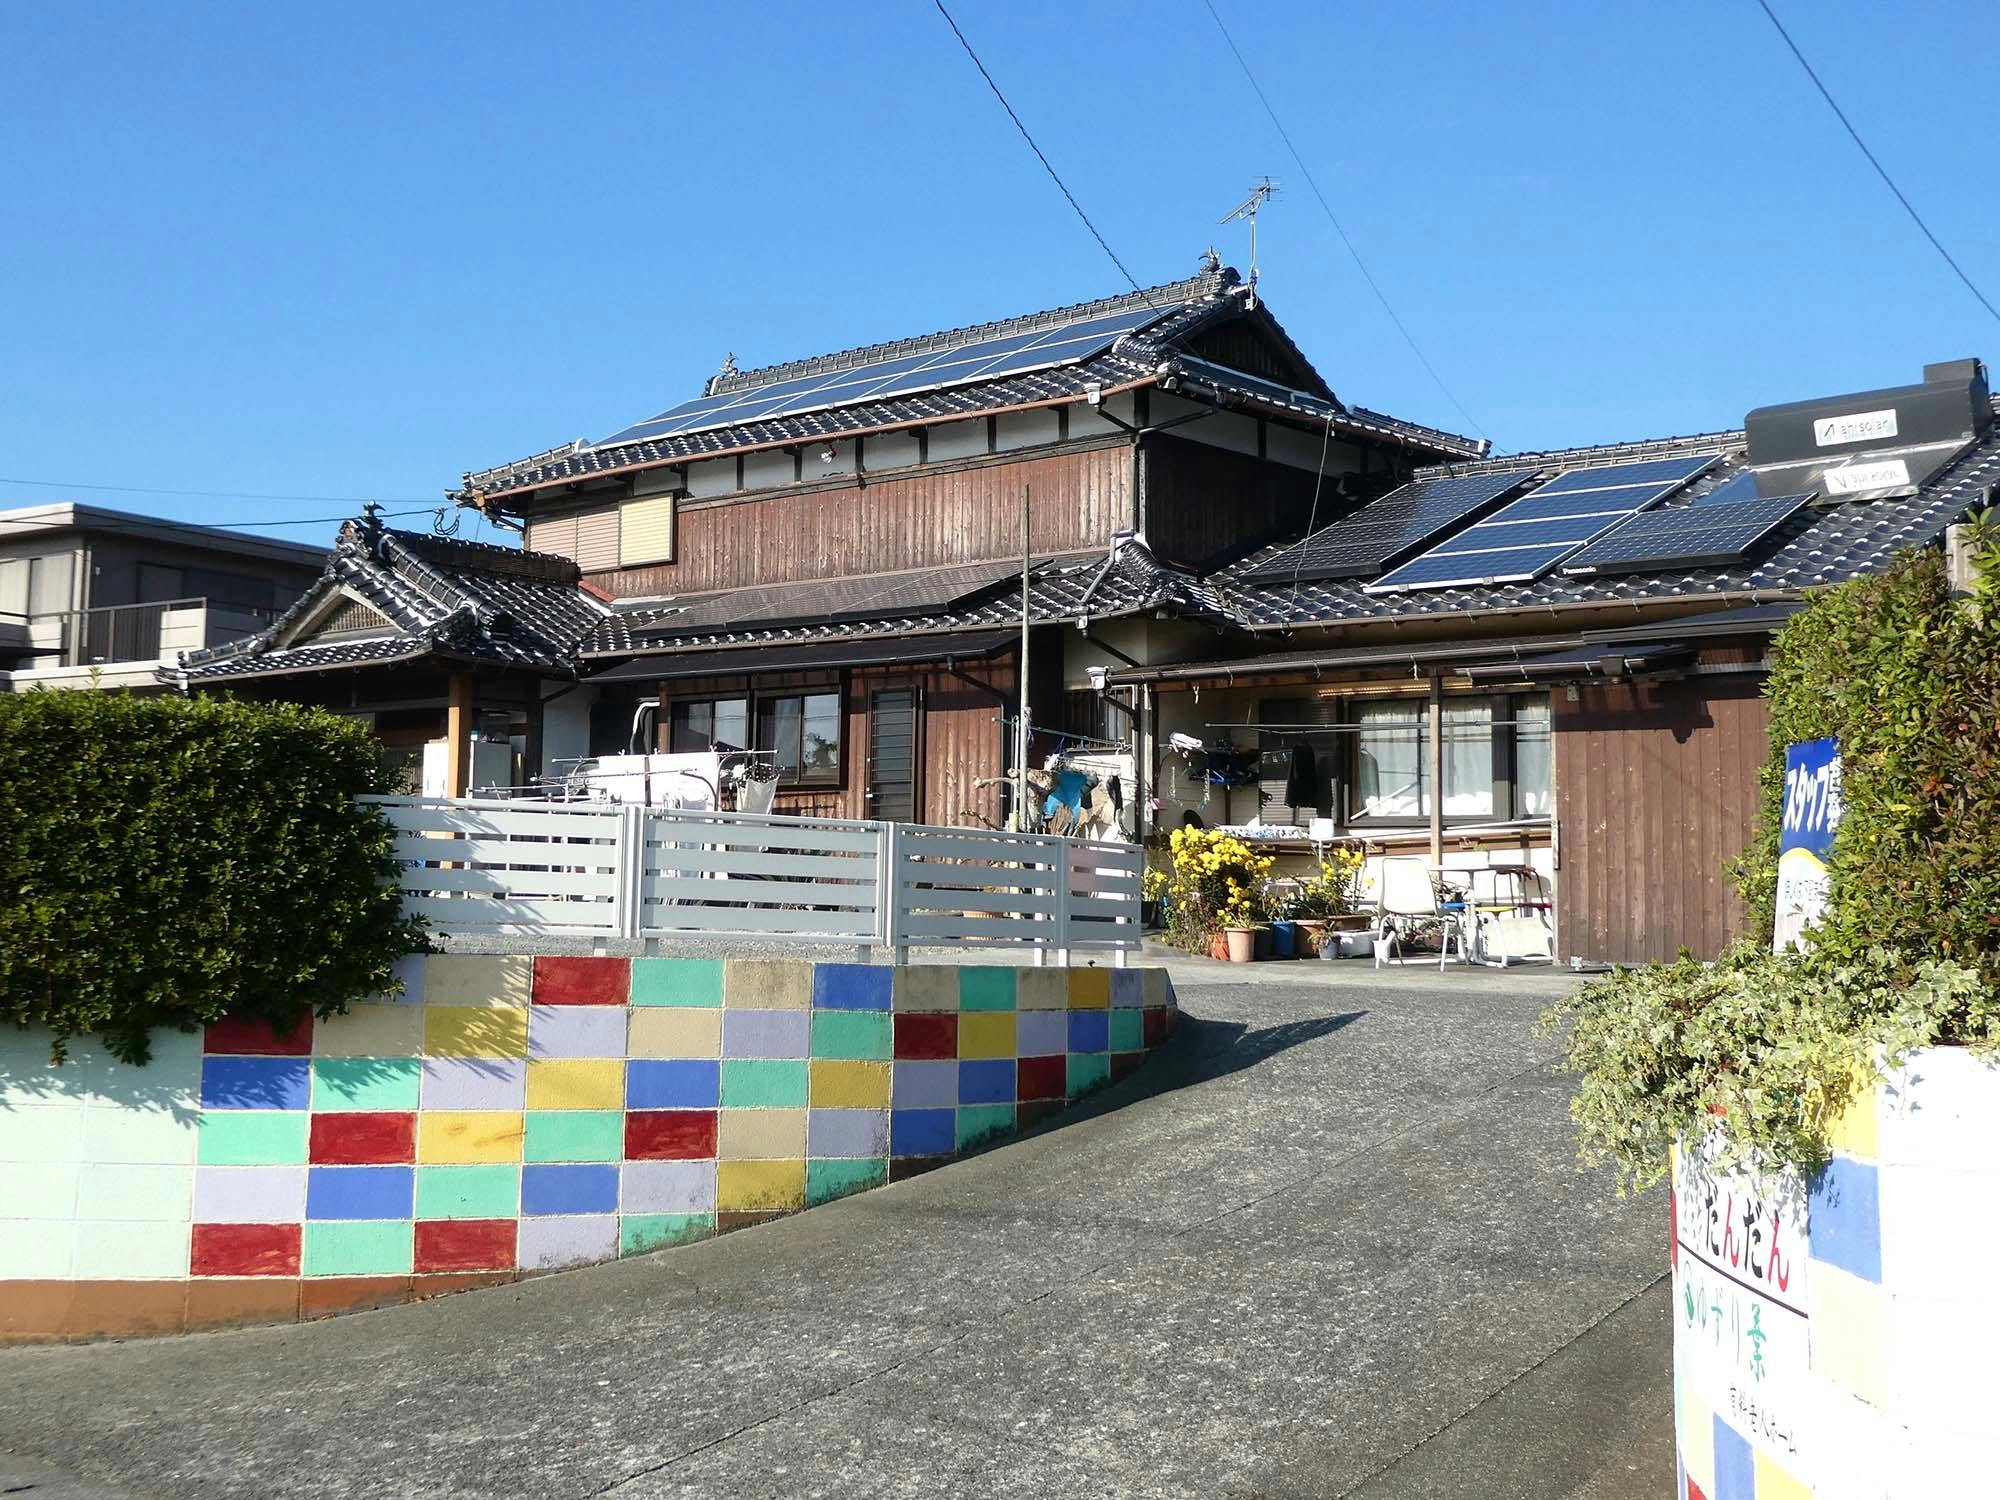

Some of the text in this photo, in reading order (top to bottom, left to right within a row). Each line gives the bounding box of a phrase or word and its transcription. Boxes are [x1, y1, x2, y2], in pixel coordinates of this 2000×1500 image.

[1783, 753, 1848, 834] スタッフ募
[1704, 1182, 1790, 1293] だんだん
